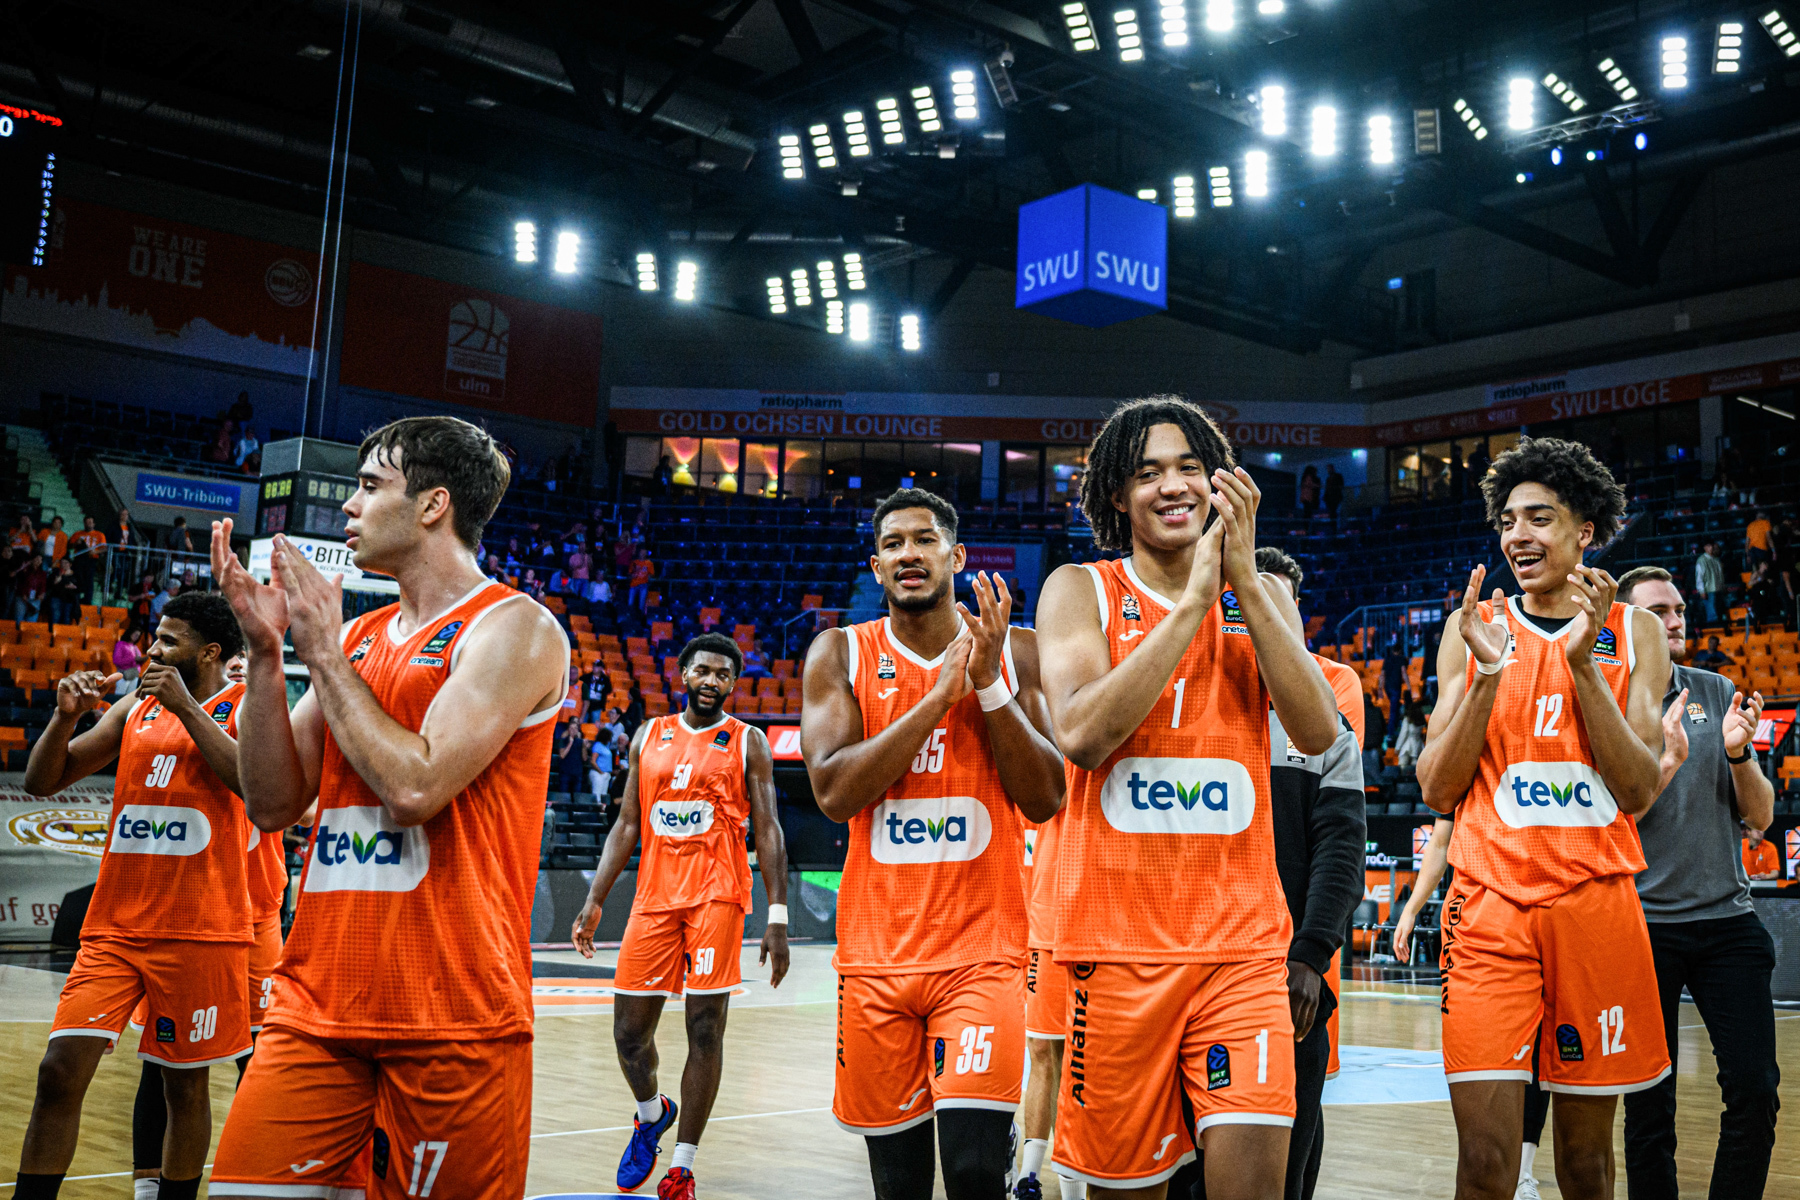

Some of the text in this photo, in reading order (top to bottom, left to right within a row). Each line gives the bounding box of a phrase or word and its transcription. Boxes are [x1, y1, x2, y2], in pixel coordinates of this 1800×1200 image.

[134, 226, 207, 257] WE ARE
[128, 244, 206, 289] ONE
[1024, 250, 1079, 292] SWU
[1096, 251, 1160, 292] SWU
[459, 376, 490, 395] ulm
[761, 395, 843, 410] ratiopharm
[1494, 379, 1565, 400] ratiopharm
[1551, 380, 1670, 421] SWU-LOGE
[659, 412, 942, 436] GOLD OCHSEN LOUNGE
[144, 482, 233, 506] SWU-Tribüne
[315, 546, 354, 566] BITE
[1171, 678, 1185, 728] 1
[1533, 694, 1563, 737] 12
[145, 754, 177, 788] 30
[671, 764, 692, 790] 50
[1127, 772, 1228, 811] teva
[118, 814, 187, 841] teva
[659, 807, 701, 827] teva
[886, 812, 966, 844] teva
[315, 825, 403, 866] teva
[695, 947, 715, 975] 50
[1027, 949, 1039, 993] Allia
[189, 1005, 218, 1043] 30
[1598, 1005, 1626, 1056] 12
[956, 1026, 995, 1075] 35
[1072, 988, 1088, 1107] Allianz
[1255, 1029, 1268, 1084] 1
[408, 1140, 449, 1198] 17
